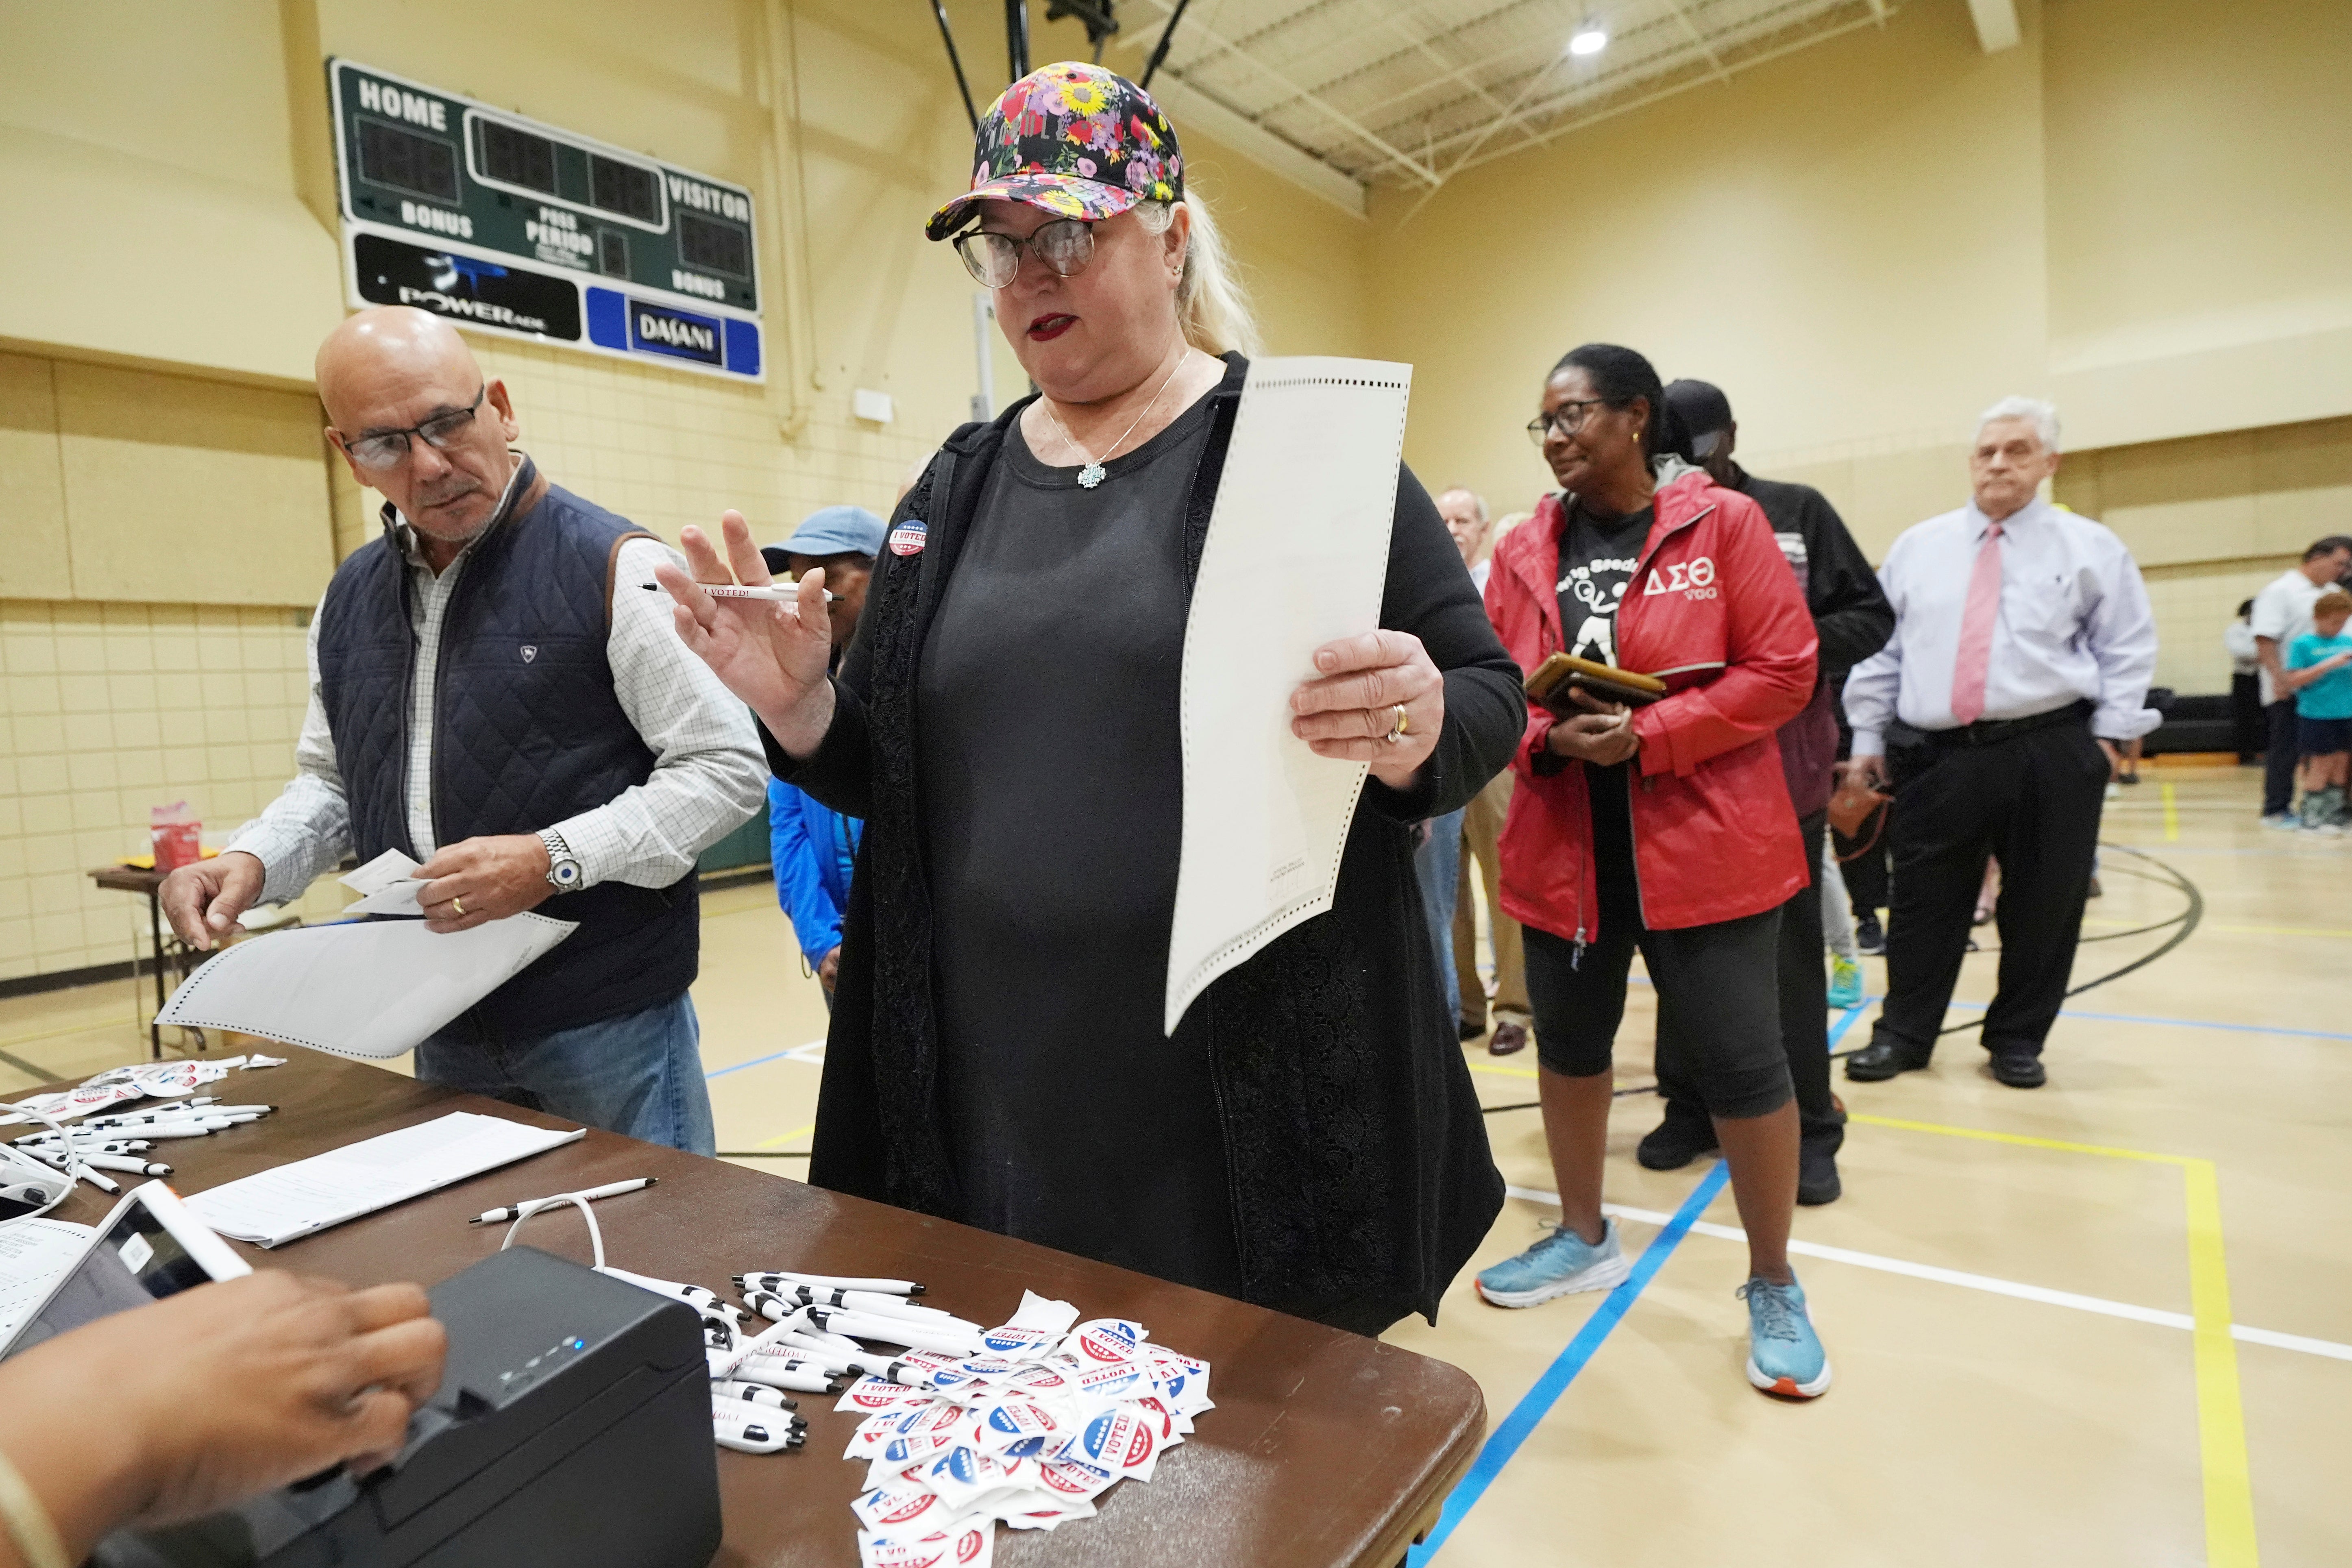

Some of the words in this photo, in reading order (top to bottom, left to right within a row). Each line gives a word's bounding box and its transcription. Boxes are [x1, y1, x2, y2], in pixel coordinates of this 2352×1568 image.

[359, 78, 447, 133] HOME
[668, 175, 749, 223] VISITOR
[401, 200, 473, 239] BONUS
[525, 219, 594, 256] PERIOD
[672, 269, 725, 300] BONUS
[640, 314, 714, 351] DASANI
[900, 532, 926, 541] VOTED
[991, 1332, 1026, 1340] VOTED
[1099, 1334, 1133, 1355] VOTED
[766, 1346, 799, 1358] VOTED!
[924, 1351, 958, 1363] VOTED
[1082, 1369, 1127, 1385] VOTED
[1105, 1414, 1130, 1455] VOTED
